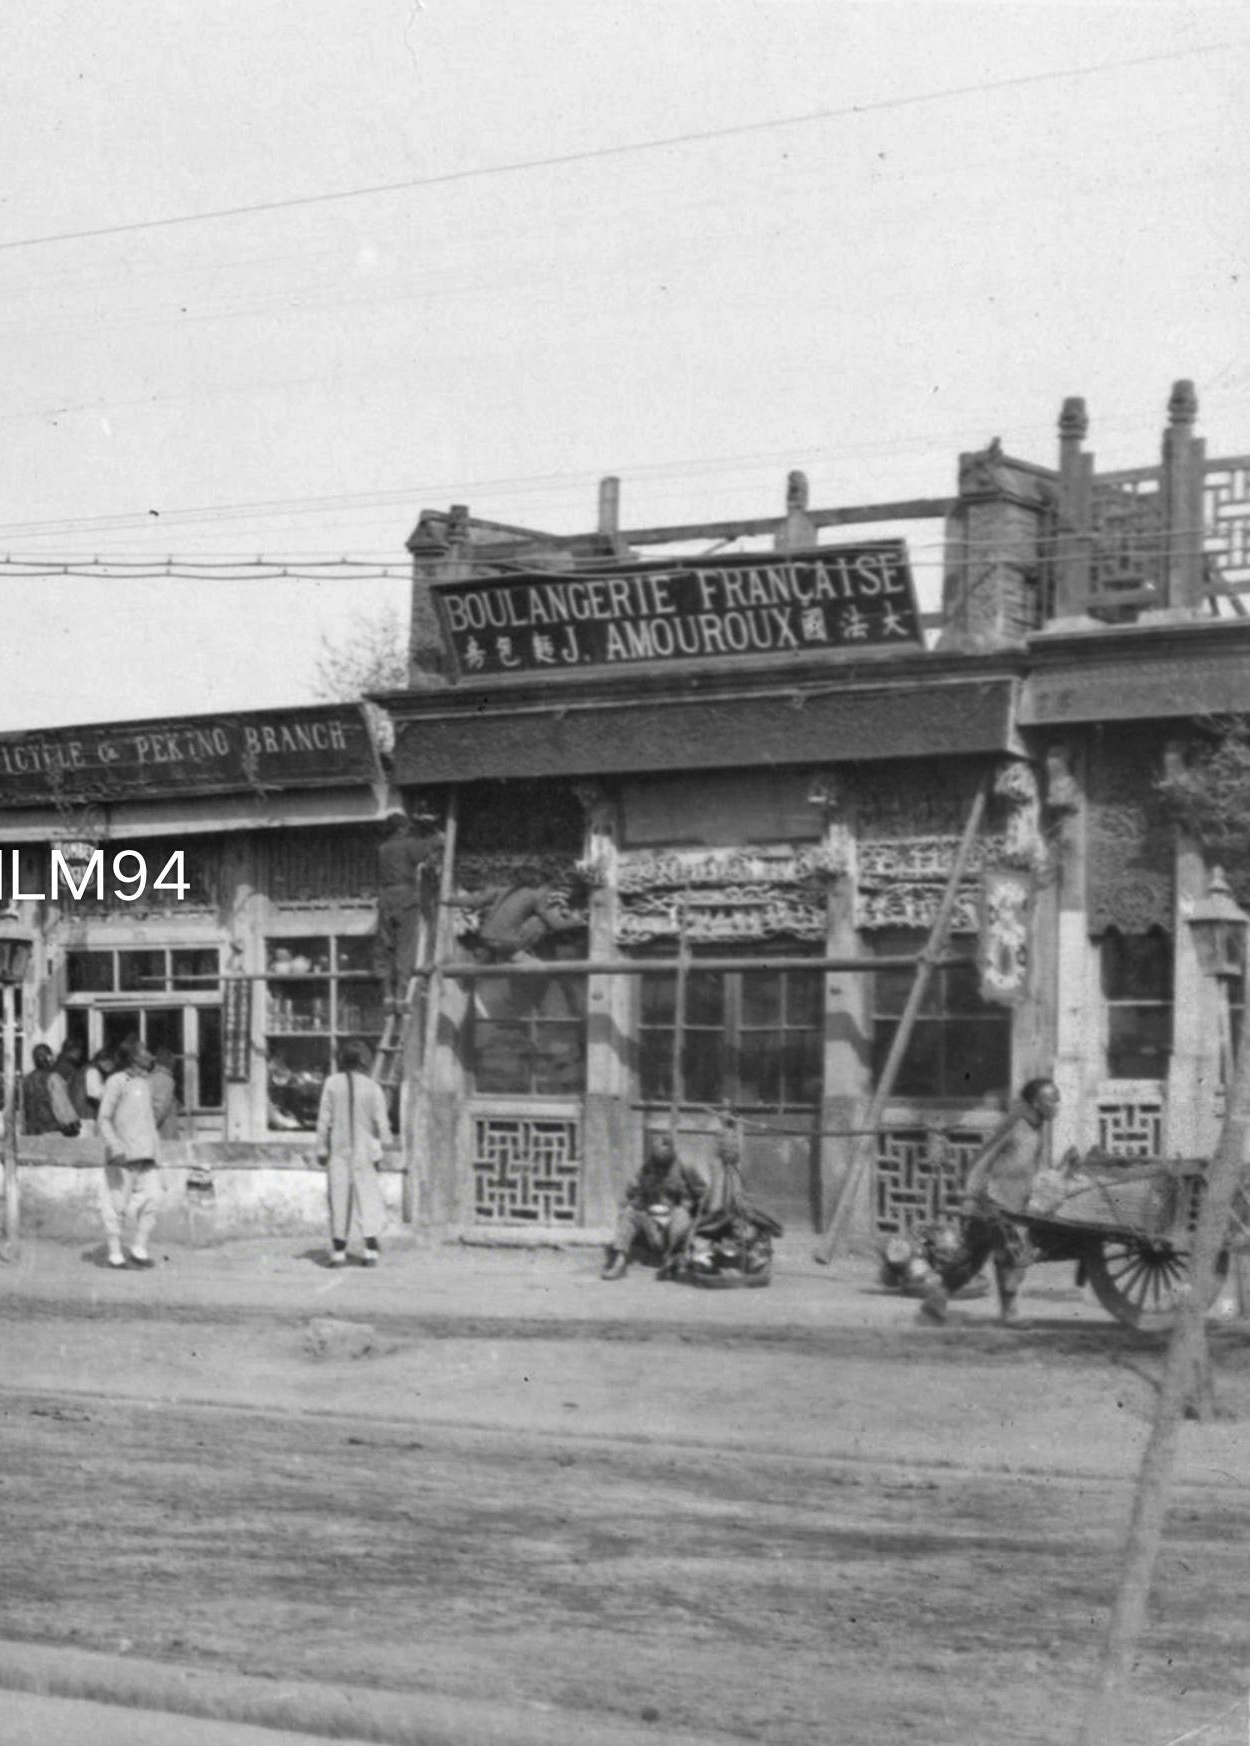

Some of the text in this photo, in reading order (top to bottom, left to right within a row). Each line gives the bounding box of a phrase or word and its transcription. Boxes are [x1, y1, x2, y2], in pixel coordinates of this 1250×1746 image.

[449, 552, 905, 631] BOULANGERIE FRANÇAISE
[561, 606, 799, 662] J. AMOUROUX
[243, 720, 347, 755] BRANCH
